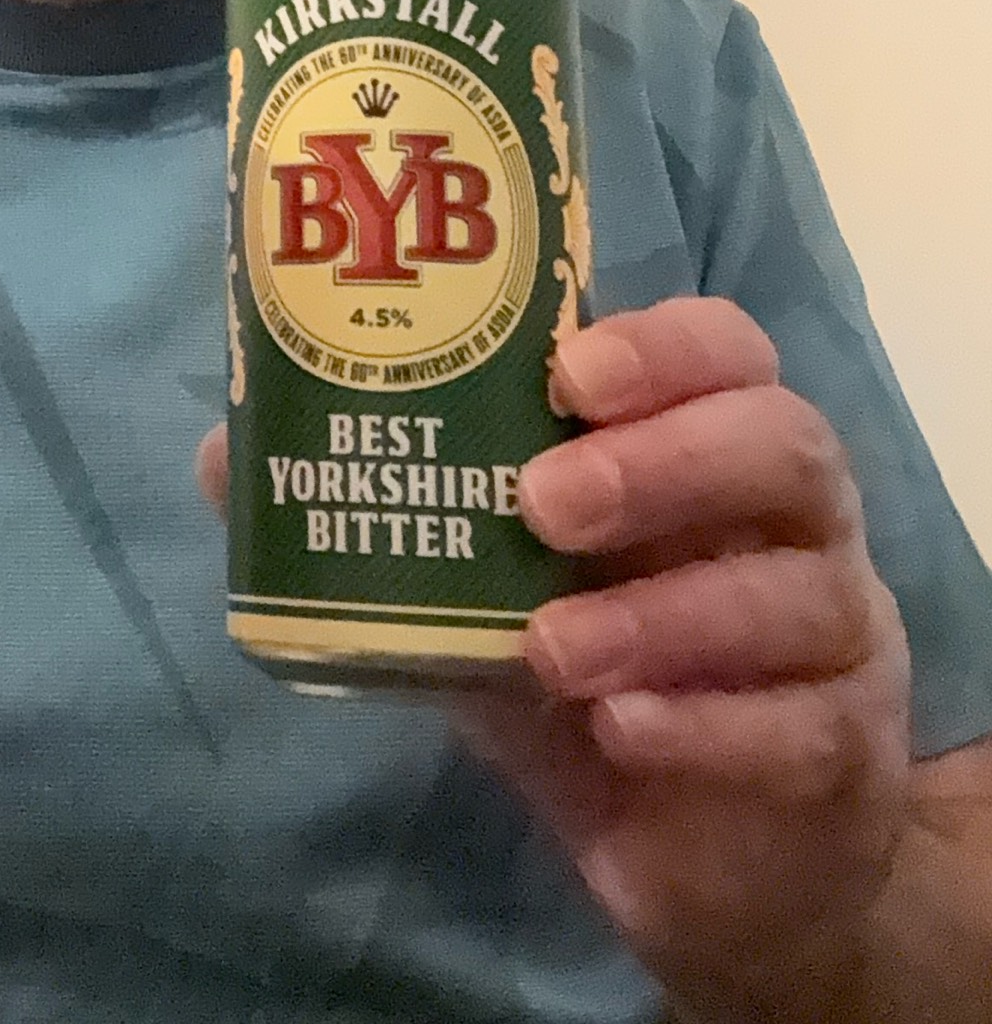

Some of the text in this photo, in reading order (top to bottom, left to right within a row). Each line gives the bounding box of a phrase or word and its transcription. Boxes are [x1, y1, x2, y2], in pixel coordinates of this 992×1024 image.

[257, 65, 312, 143] CELEBRATING
[310, 50, 336, 74] THE
[372, 42, 471, 91] ANNIVERSARY
[466, 84, 488, 105] OF
[481, 103, 512, 142] ASDA
[270, 130, 499, 284] BYB
[264, 299, 324, 368] CELEBRATING
[324, 352, 348, 379] THE
[383, 341, 476, 385] ANNIVERSARY
[471, 329, 491, 354] OF
[486, 303, 516, 342] ASDA
[349, 307, 414, 330] 4.5%
[327, 412, 444, 459] BEST
[268, 456, 521, 516] YORKSHIRE
[306, 509, 475, 559] BITTER
